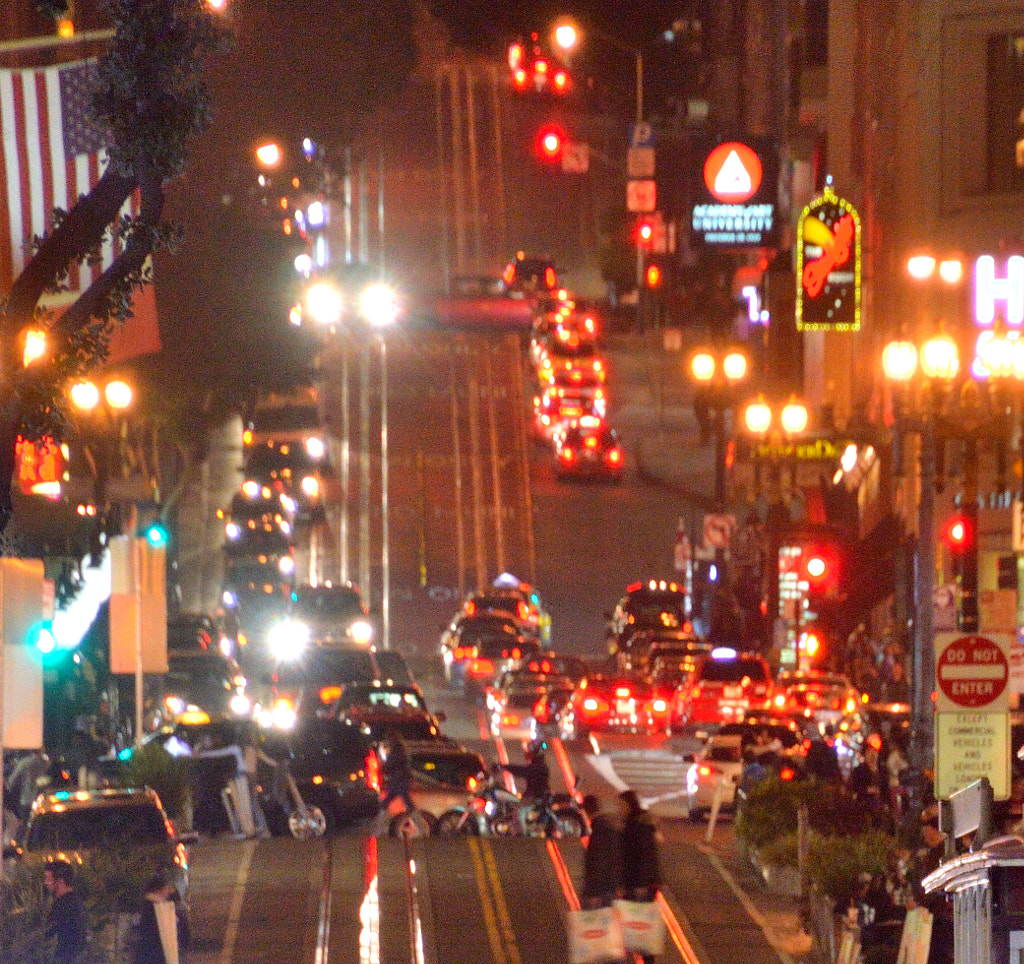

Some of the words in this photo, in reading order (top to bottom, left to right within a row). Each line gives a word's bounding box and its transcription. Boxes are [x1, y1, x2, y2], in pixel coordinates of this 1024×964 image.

[947, 649, 966, 662] DO
[972, 648, 998, 662] NOT
[952, 682, 993, 695] ENTER
